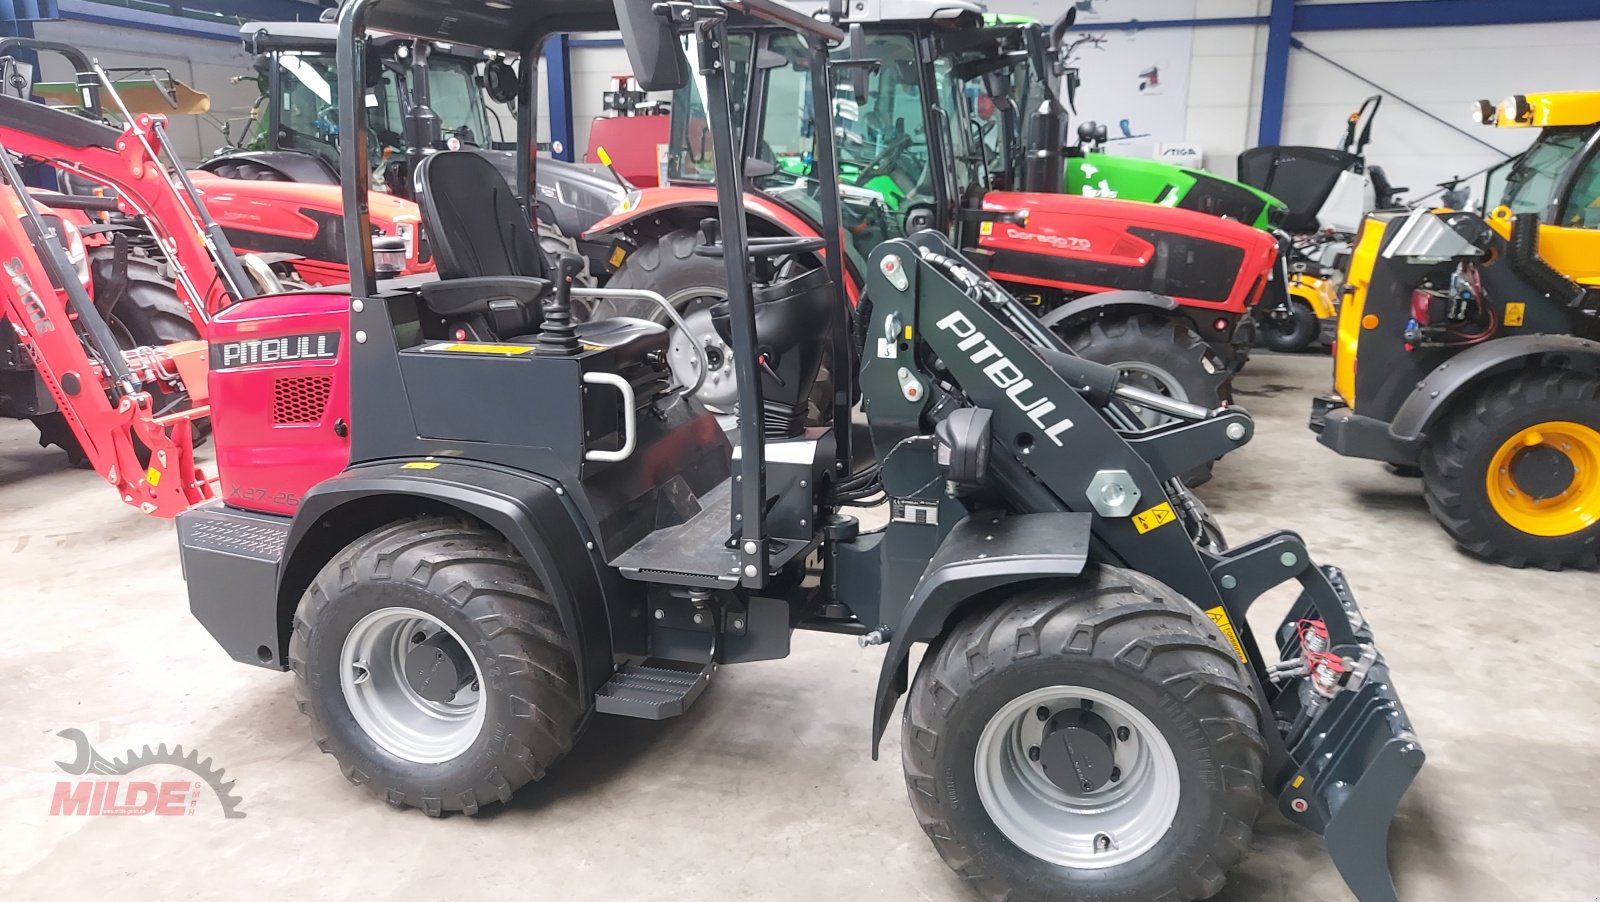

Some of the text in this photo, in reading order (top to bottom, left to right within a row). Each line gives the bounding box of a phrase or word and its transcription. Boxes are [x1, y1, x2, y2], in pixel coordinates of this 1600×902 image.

[1163, 148, 1196, 156] STIGA
[223, 335, 334, 366] PITBULL
[936, 310, 1075, 448] PITBULL
[231, 484, 303, 506] X27-26
